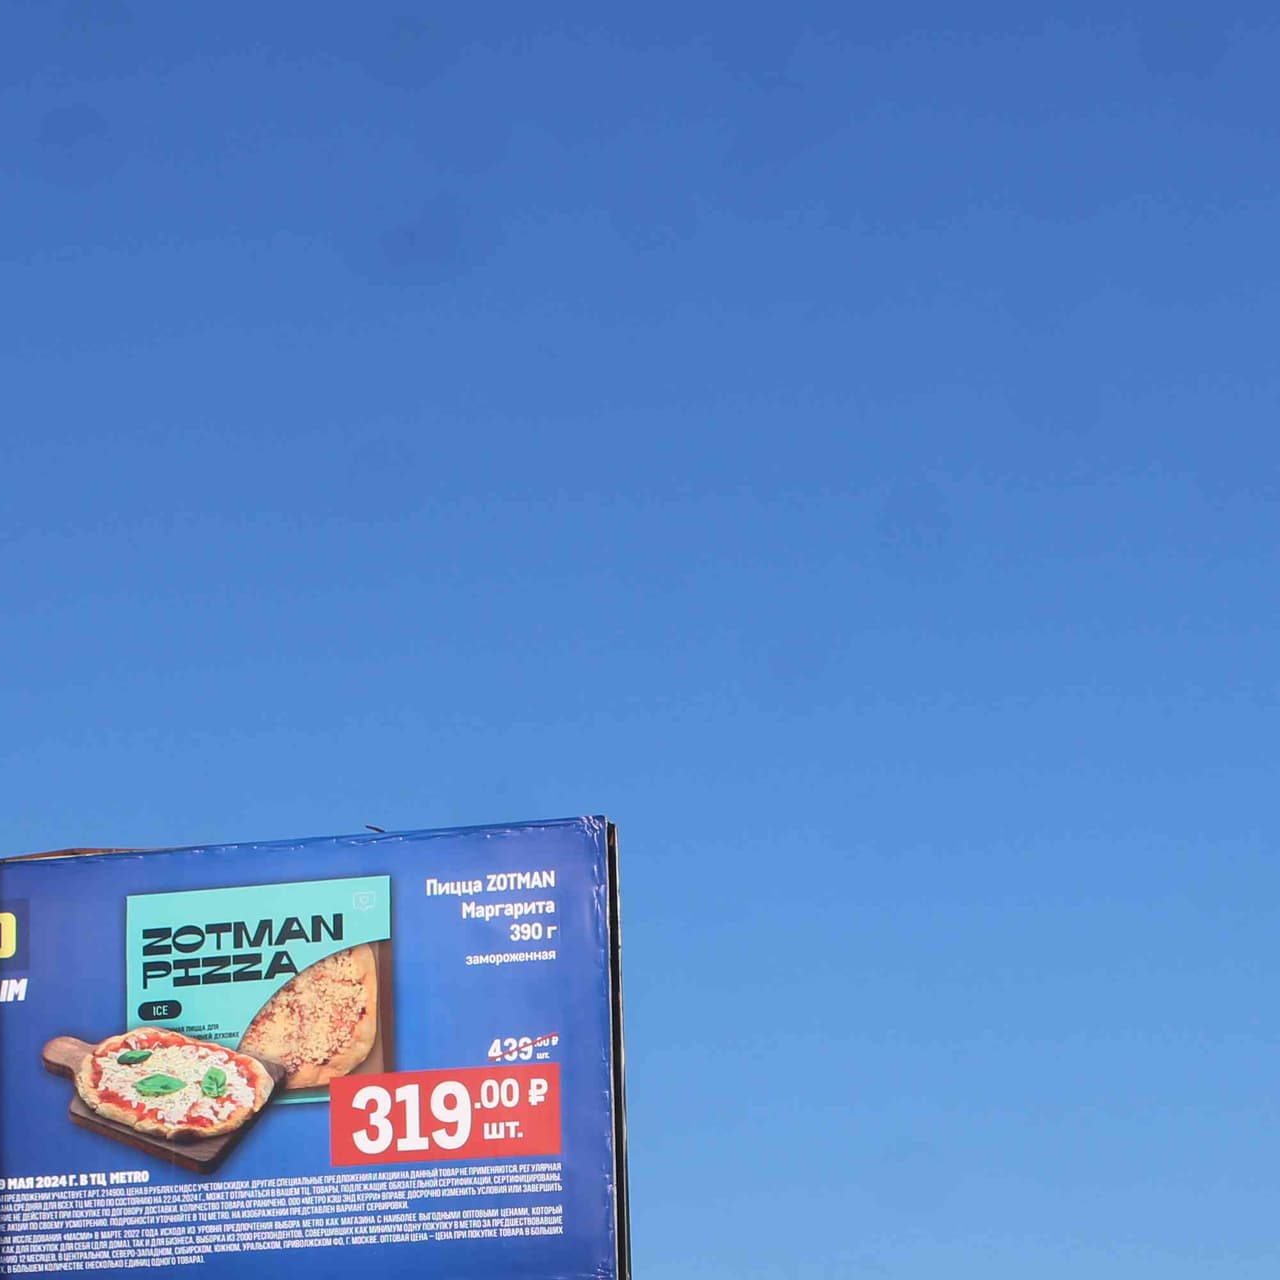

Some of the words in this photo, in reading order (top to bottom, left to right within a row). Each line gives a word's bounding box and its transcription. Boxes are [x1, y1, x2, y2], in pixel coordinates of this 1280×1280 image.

[426, 878, 483, 897] Пицца
[486, 870, 555, 892] ZOTMAN
[462, 900, 555, 921] Маргарита
[142, 913, 344, 957] ZOTMAN
[509, 922, 543, 941] 390
[546, 925, 557, 939] г
[465, 950, 557, 966] замороженная
[142, 950, 299, 990] PIZZA
[152, 1005, 169, 1016] ICE
[483, 1120, 524, 1140] шт.
[7, 1176, 33, 1190] МАЯ
[35, 1175, 66, 1188] 2024
[68, 1174, 77, 1187] Г.
[80, 1173, 88, 1186] В
[89, 1172, 106, 1185] ТЦ
[110, 1170, 149, 1184] METRO
